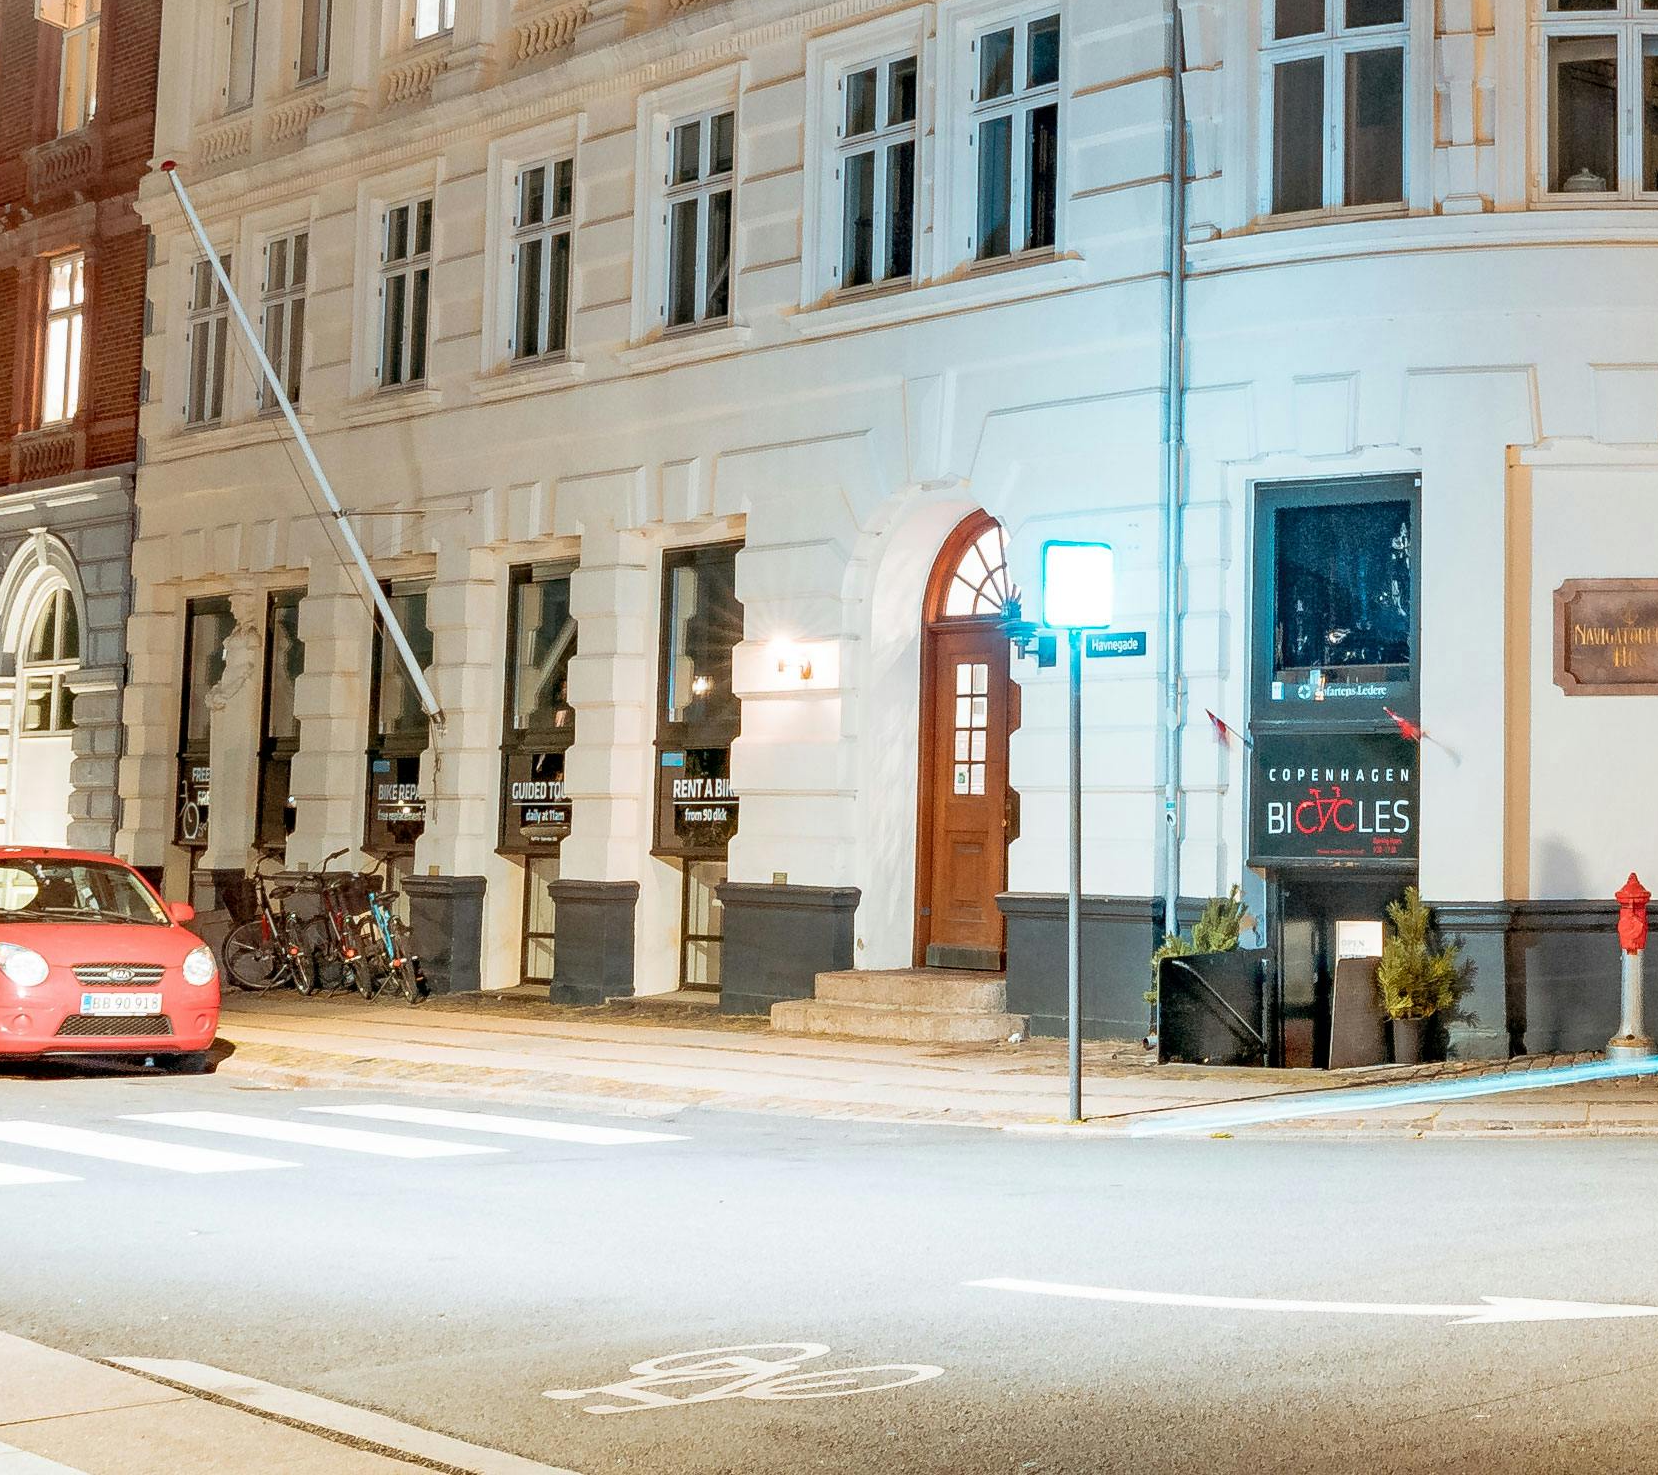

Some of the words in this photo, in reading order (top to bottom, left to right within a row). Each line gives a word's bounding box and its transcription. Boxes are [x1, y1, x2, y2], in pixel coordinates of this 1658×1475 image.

[1092, 637, 1138, 653] Havnegade
[1357, 685, 1387, 698] Ledere
[1268, 768, 1409, 782] COPENHAGEN
[378, 784, 398, 800] BIKE
[512, 782, 547, 800] GUIDED
[548, 781, 567, 799] TOU
[673, 779, 704, 798] RENT
[704, 779, 713, 798] A
[715, 778, 735, 797] BIK
[685, 808, 702, 821] from
[1268, 796, 1410, 834] BICYCLES
[92, 997, 111, 1009] BB
[115, 997, 131, 1009] 90
[135, 997, 159, 1009] 918
